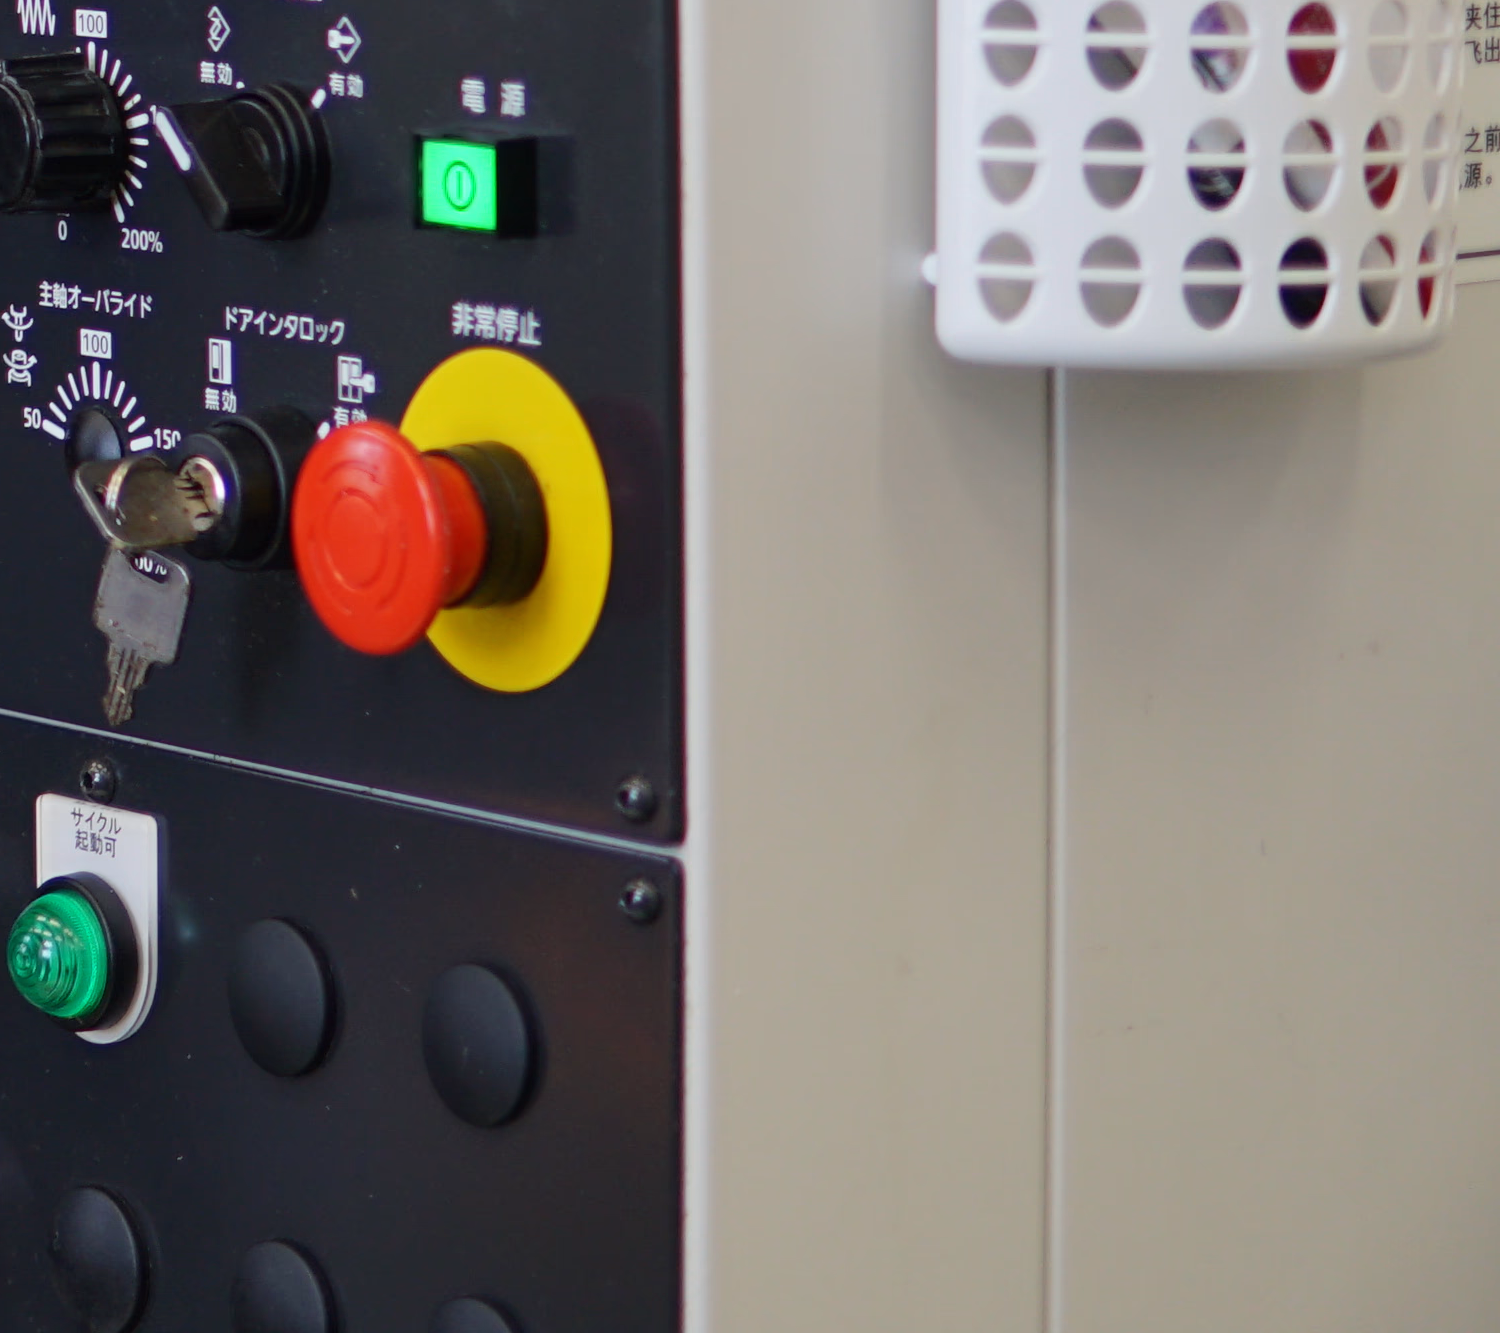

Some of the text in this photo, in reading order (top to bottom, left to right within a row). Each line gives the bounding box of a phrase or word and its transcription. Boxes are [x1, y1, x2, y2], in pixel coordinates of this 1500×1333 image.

[78, 14, 104, 34] 100
[200, 62, 233, 85] 無効
[329, 73, 364, 98] 有効
[461, 78, 525, 117] 電源
[122, 228, 163, 253] 200%
[39, 280, 152, 317] 主軸オーバライド
[225, 305, 345, 345] ドアインタロック
[453, 302, 541, 347] 非常停止
[83, 334, 109, 355] 100
[205, 388, 237, 414] 無効
[24, 408, 41, 428] 50
[71, 807, 122, 835] サイクル
[75, 829, 117, 858] 起動可
